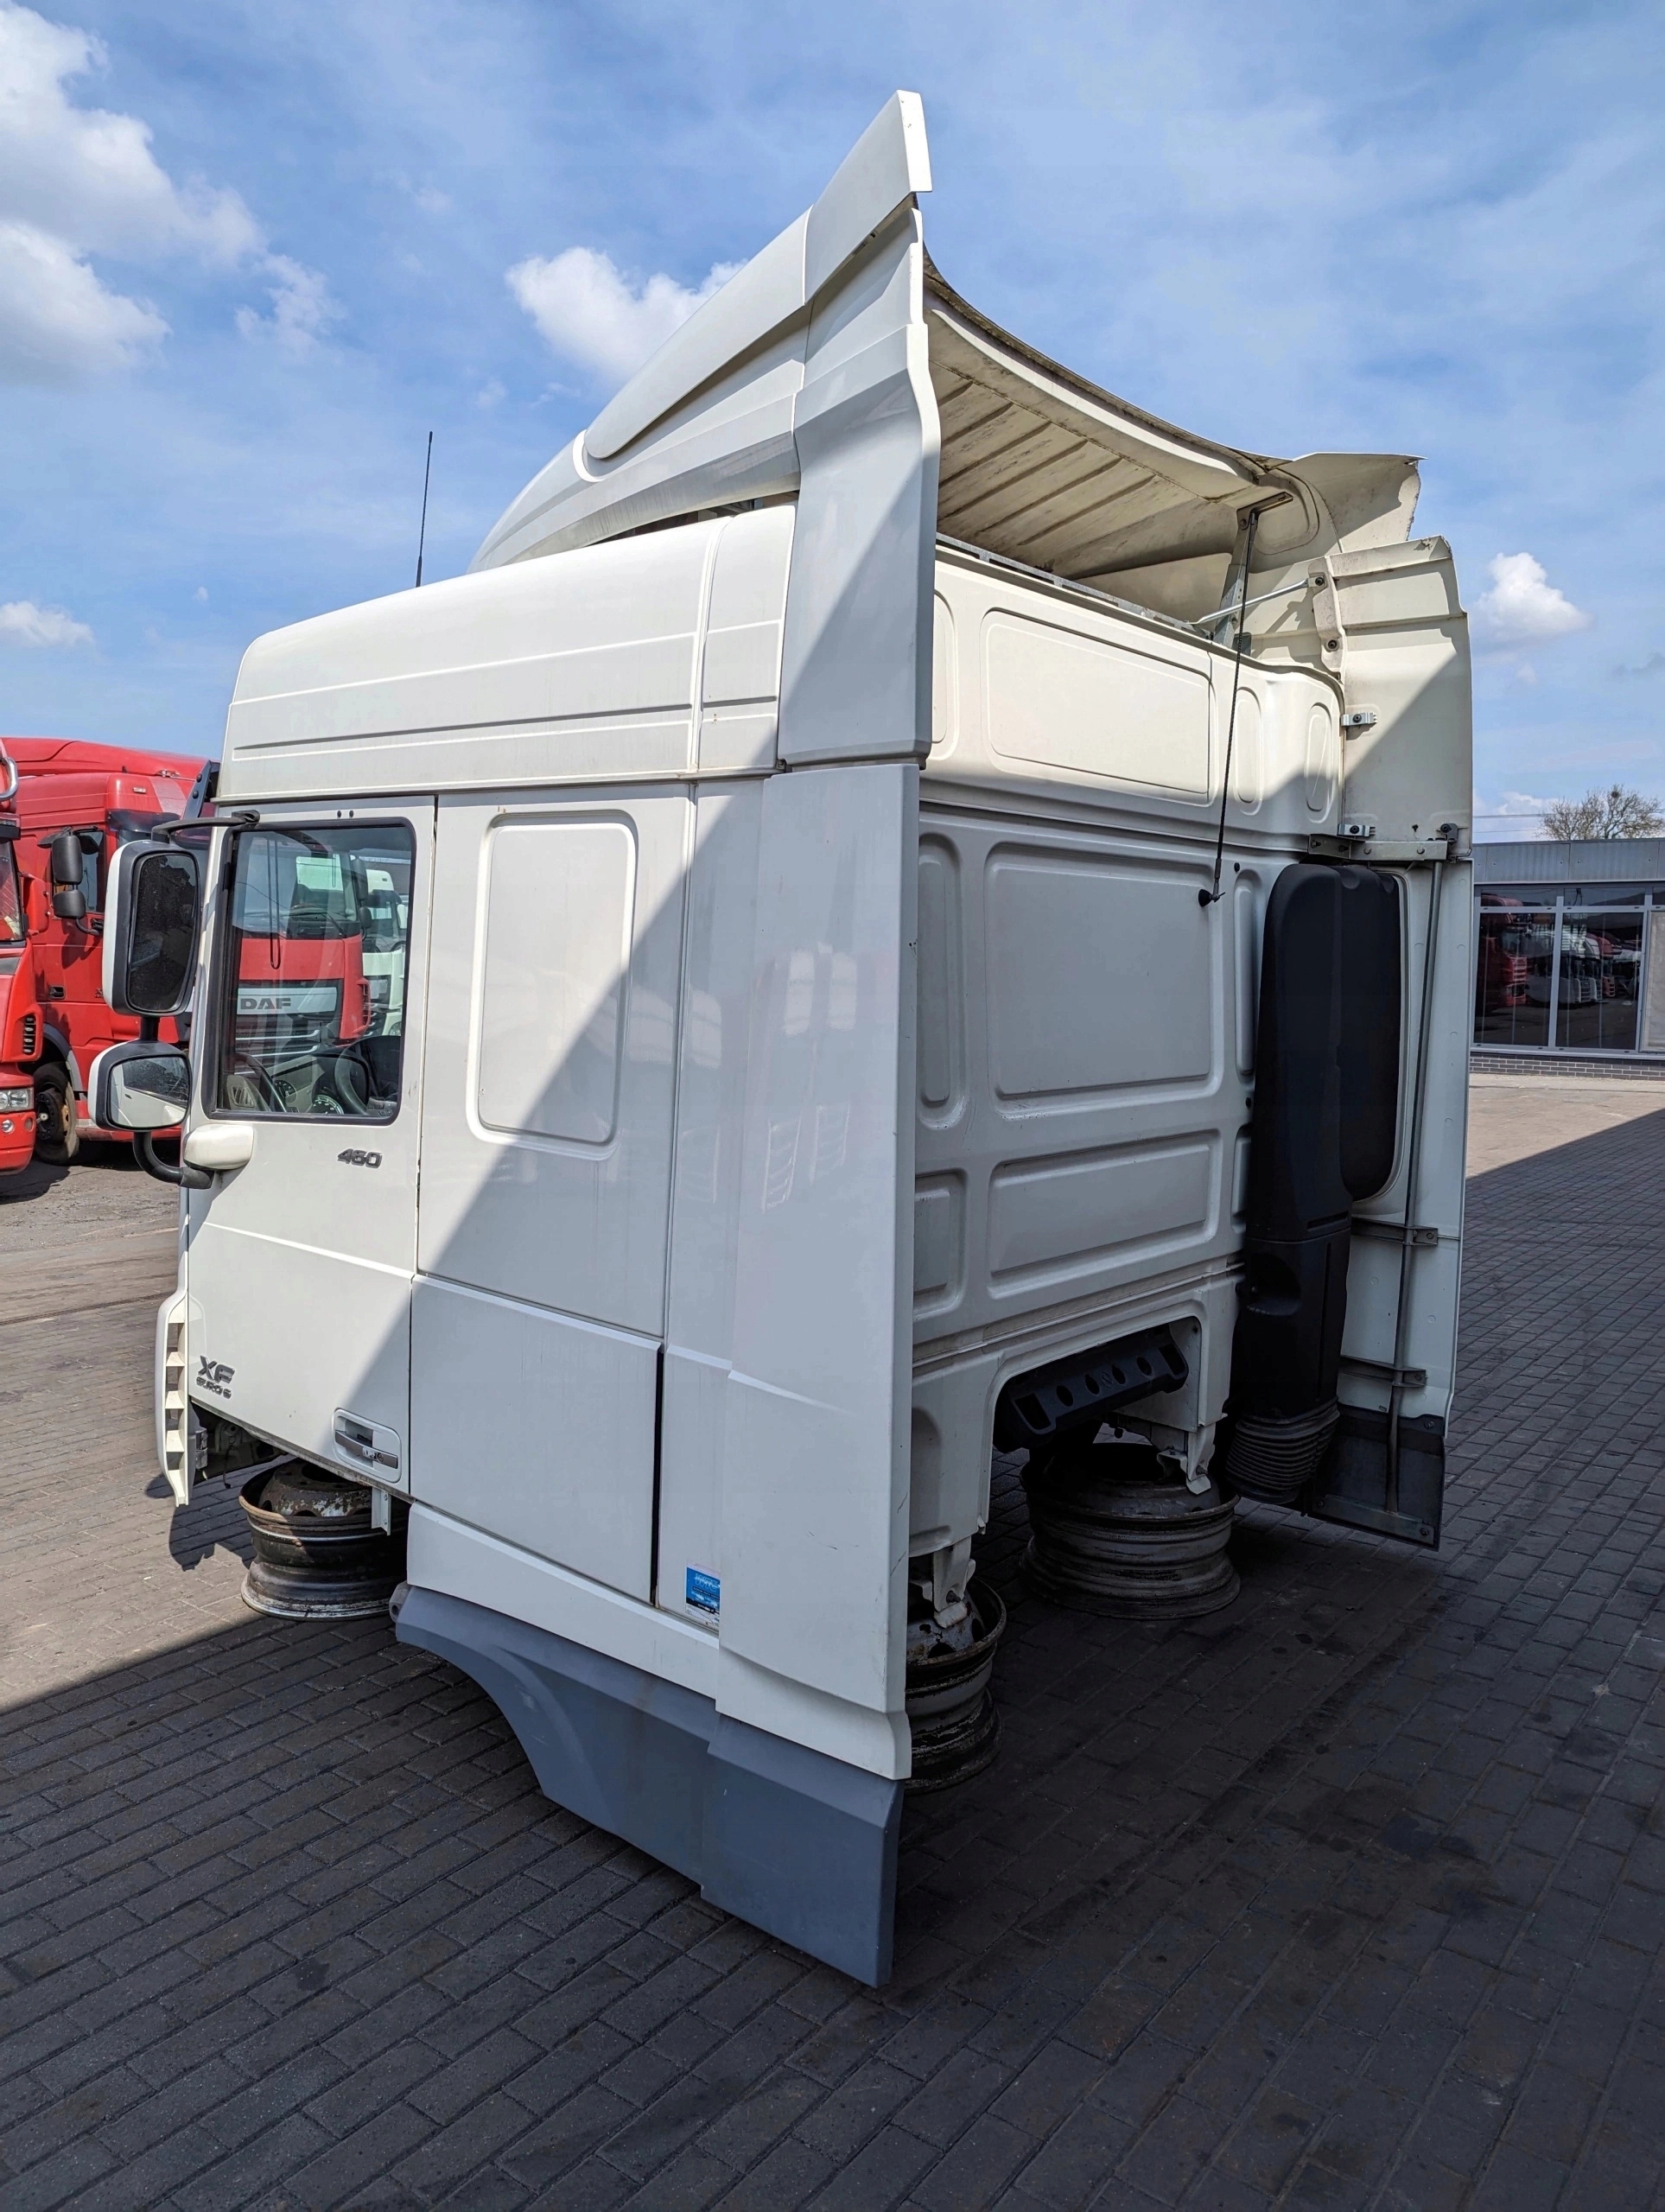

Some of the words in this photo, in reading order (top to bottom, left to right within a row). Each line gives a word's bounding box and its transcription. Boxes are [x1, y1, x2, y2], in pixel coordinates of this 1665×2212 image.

[240, 998, 291, 1010] DAF
[338, 1148, 382, 1168] 460
[198, 1356, 235, 1384] XF
[196, 1376, 223, 1395] EURO
[223, 1388, 232, 1399] 6
